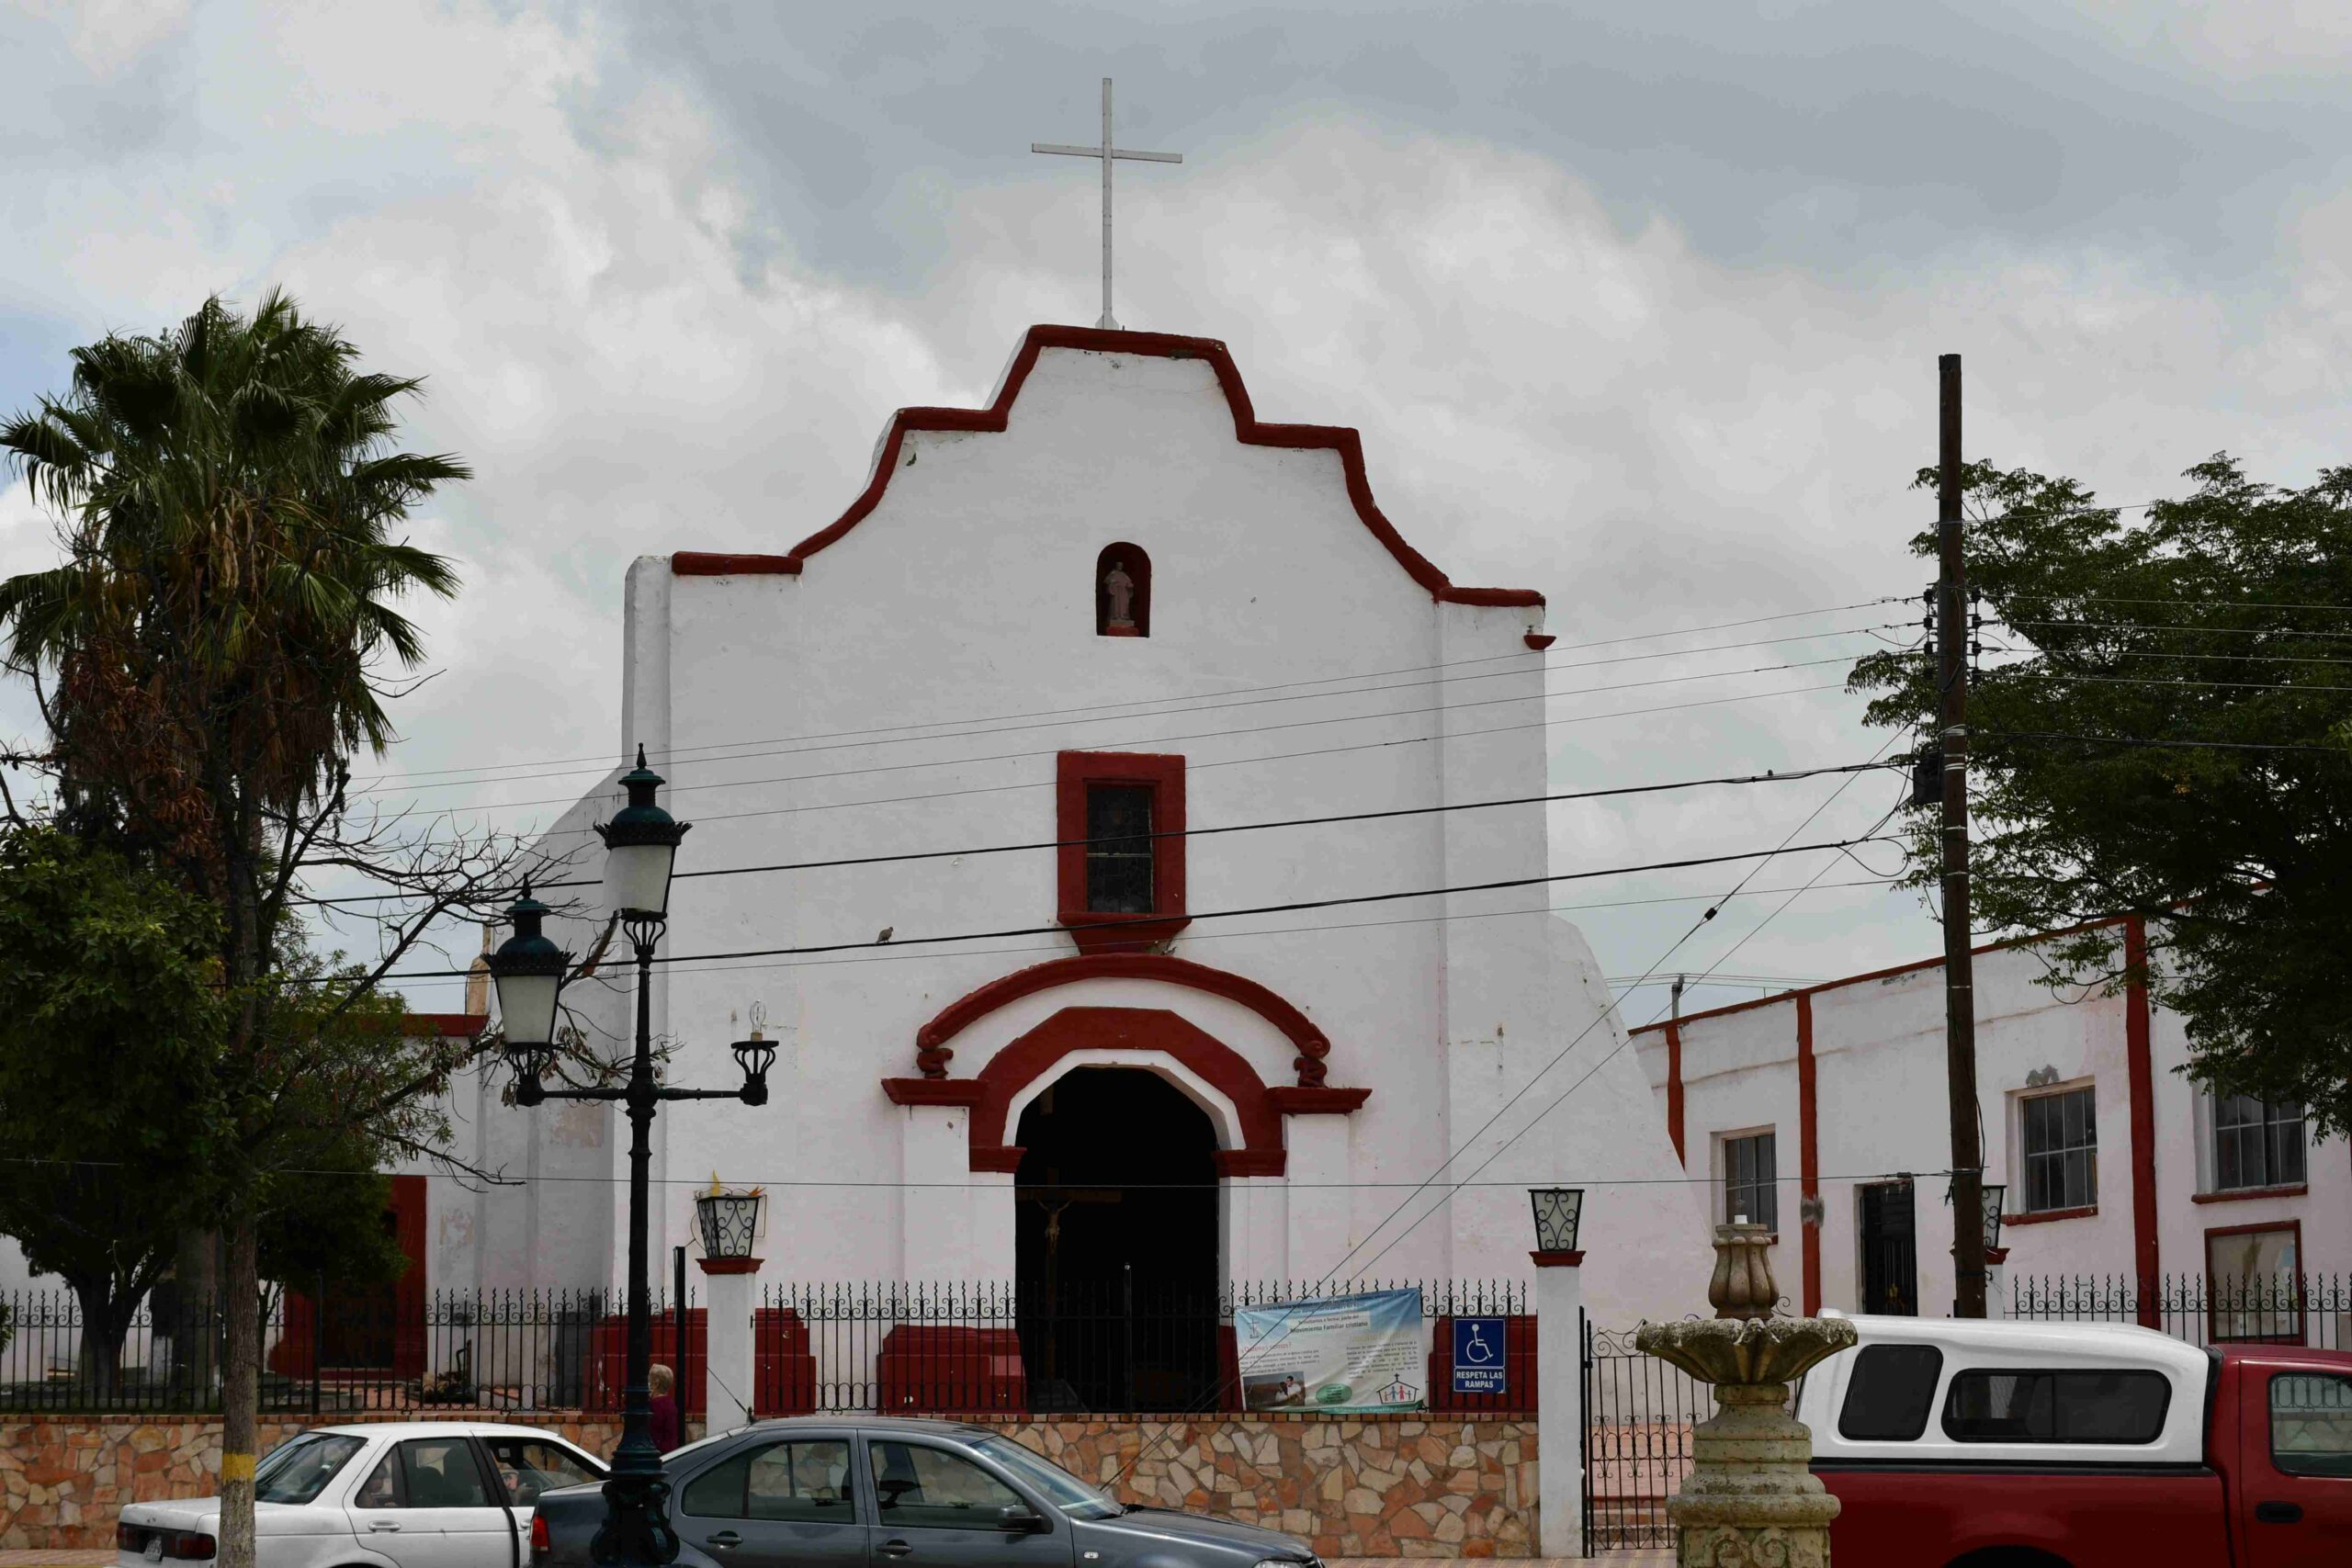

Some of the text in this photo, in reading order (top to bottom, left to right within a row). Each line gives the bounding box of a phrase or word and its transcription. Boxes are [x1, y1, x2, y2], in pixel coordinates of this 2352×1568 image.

[1456, 1371, 1502, 1379] RESPETA LAS
[1465, 1380, 1494, 1388] RAMPAS
